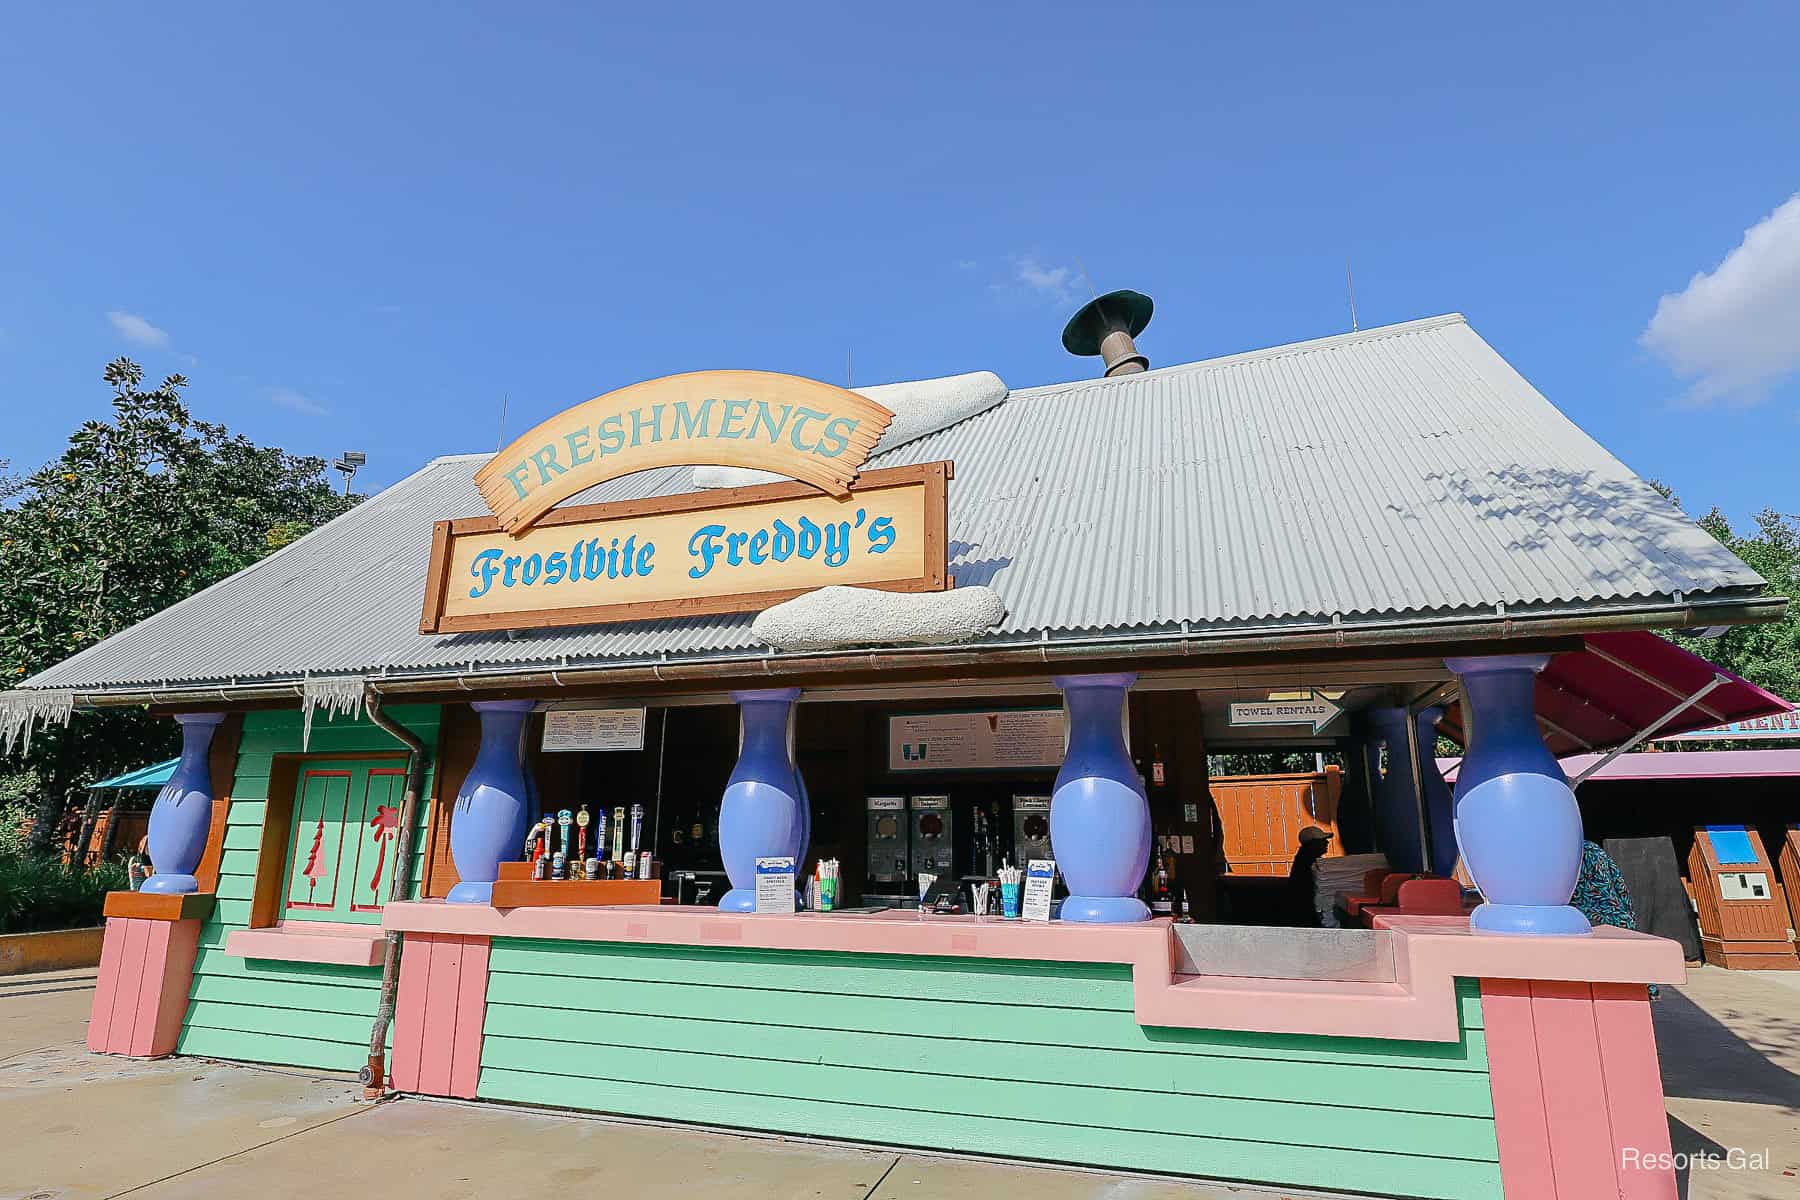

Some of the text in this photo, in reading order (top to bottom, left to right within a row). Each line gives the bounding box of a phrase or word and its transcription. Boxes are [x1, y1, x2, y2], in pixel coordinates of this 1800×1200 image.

[503, 398, 860, 500] FRESHMENTS
[469, 508, 897, 598] Frostbite Freddy's
[1236, 706, 1326, 716] TOWEL RENTALS
